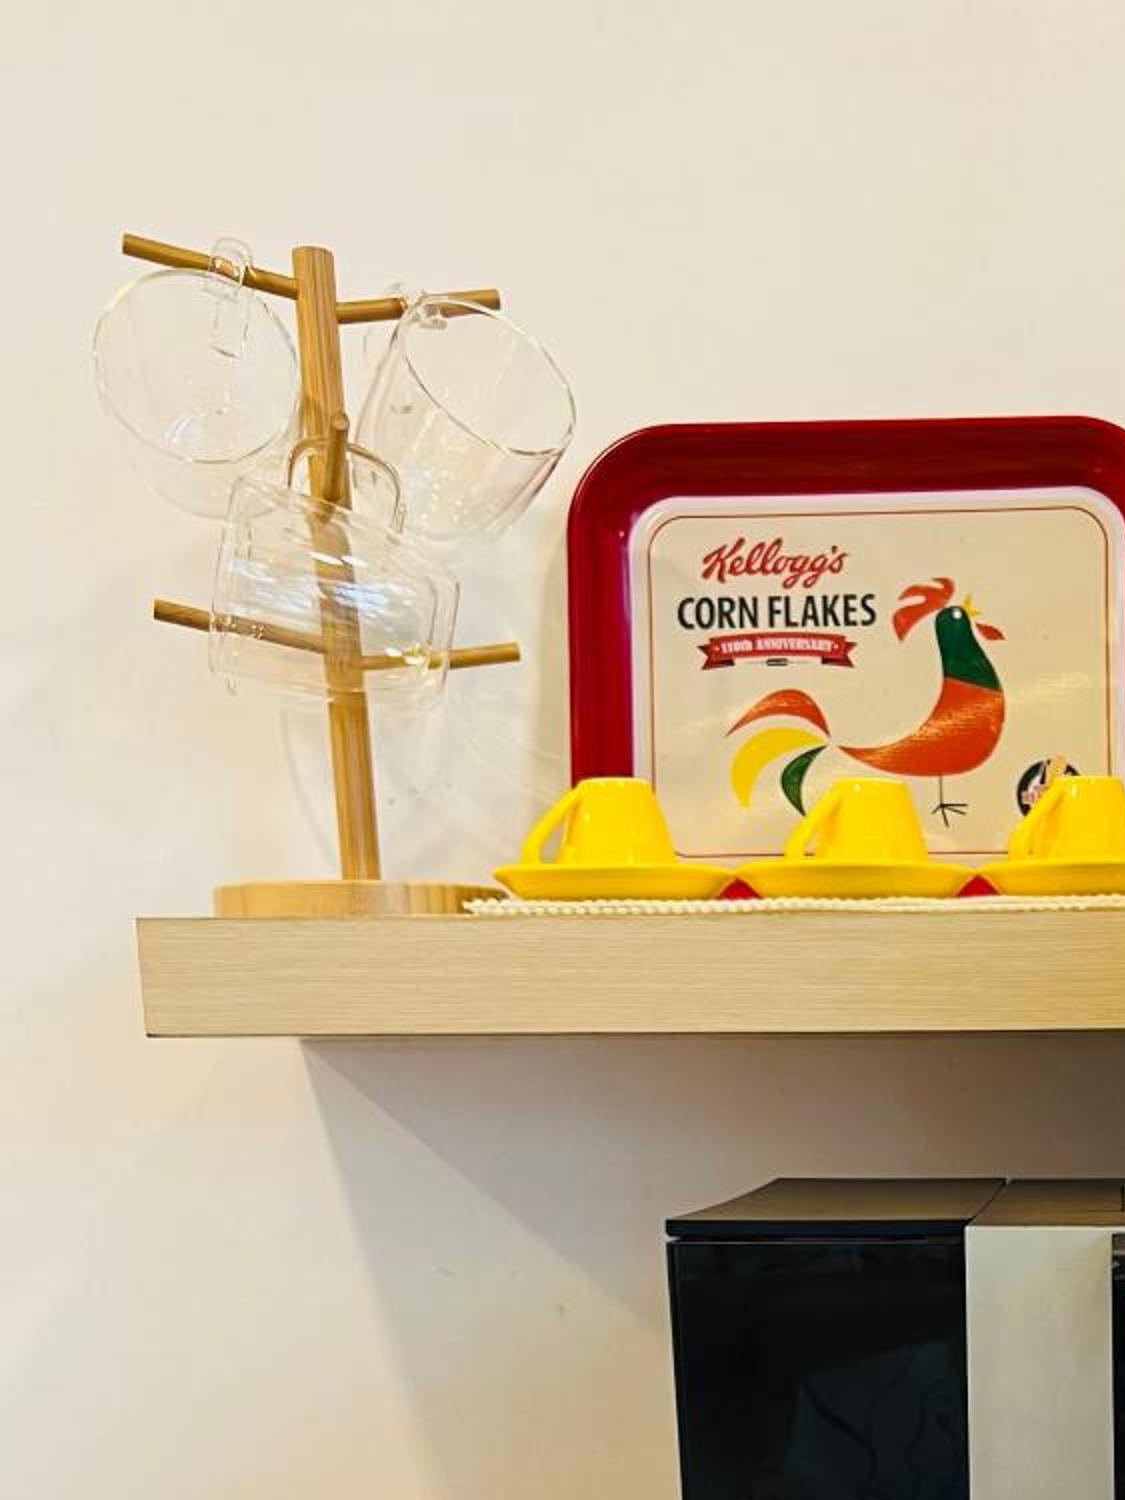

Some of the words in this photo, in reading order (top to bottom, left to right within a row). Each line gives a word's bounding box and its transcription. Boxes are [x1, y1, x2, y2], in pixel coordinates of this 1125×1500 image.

[702, 537, 848, 589] Kellogg's
[677, 596, 759, 629] CORN
[768, 593, 877, 628] FLAKES
